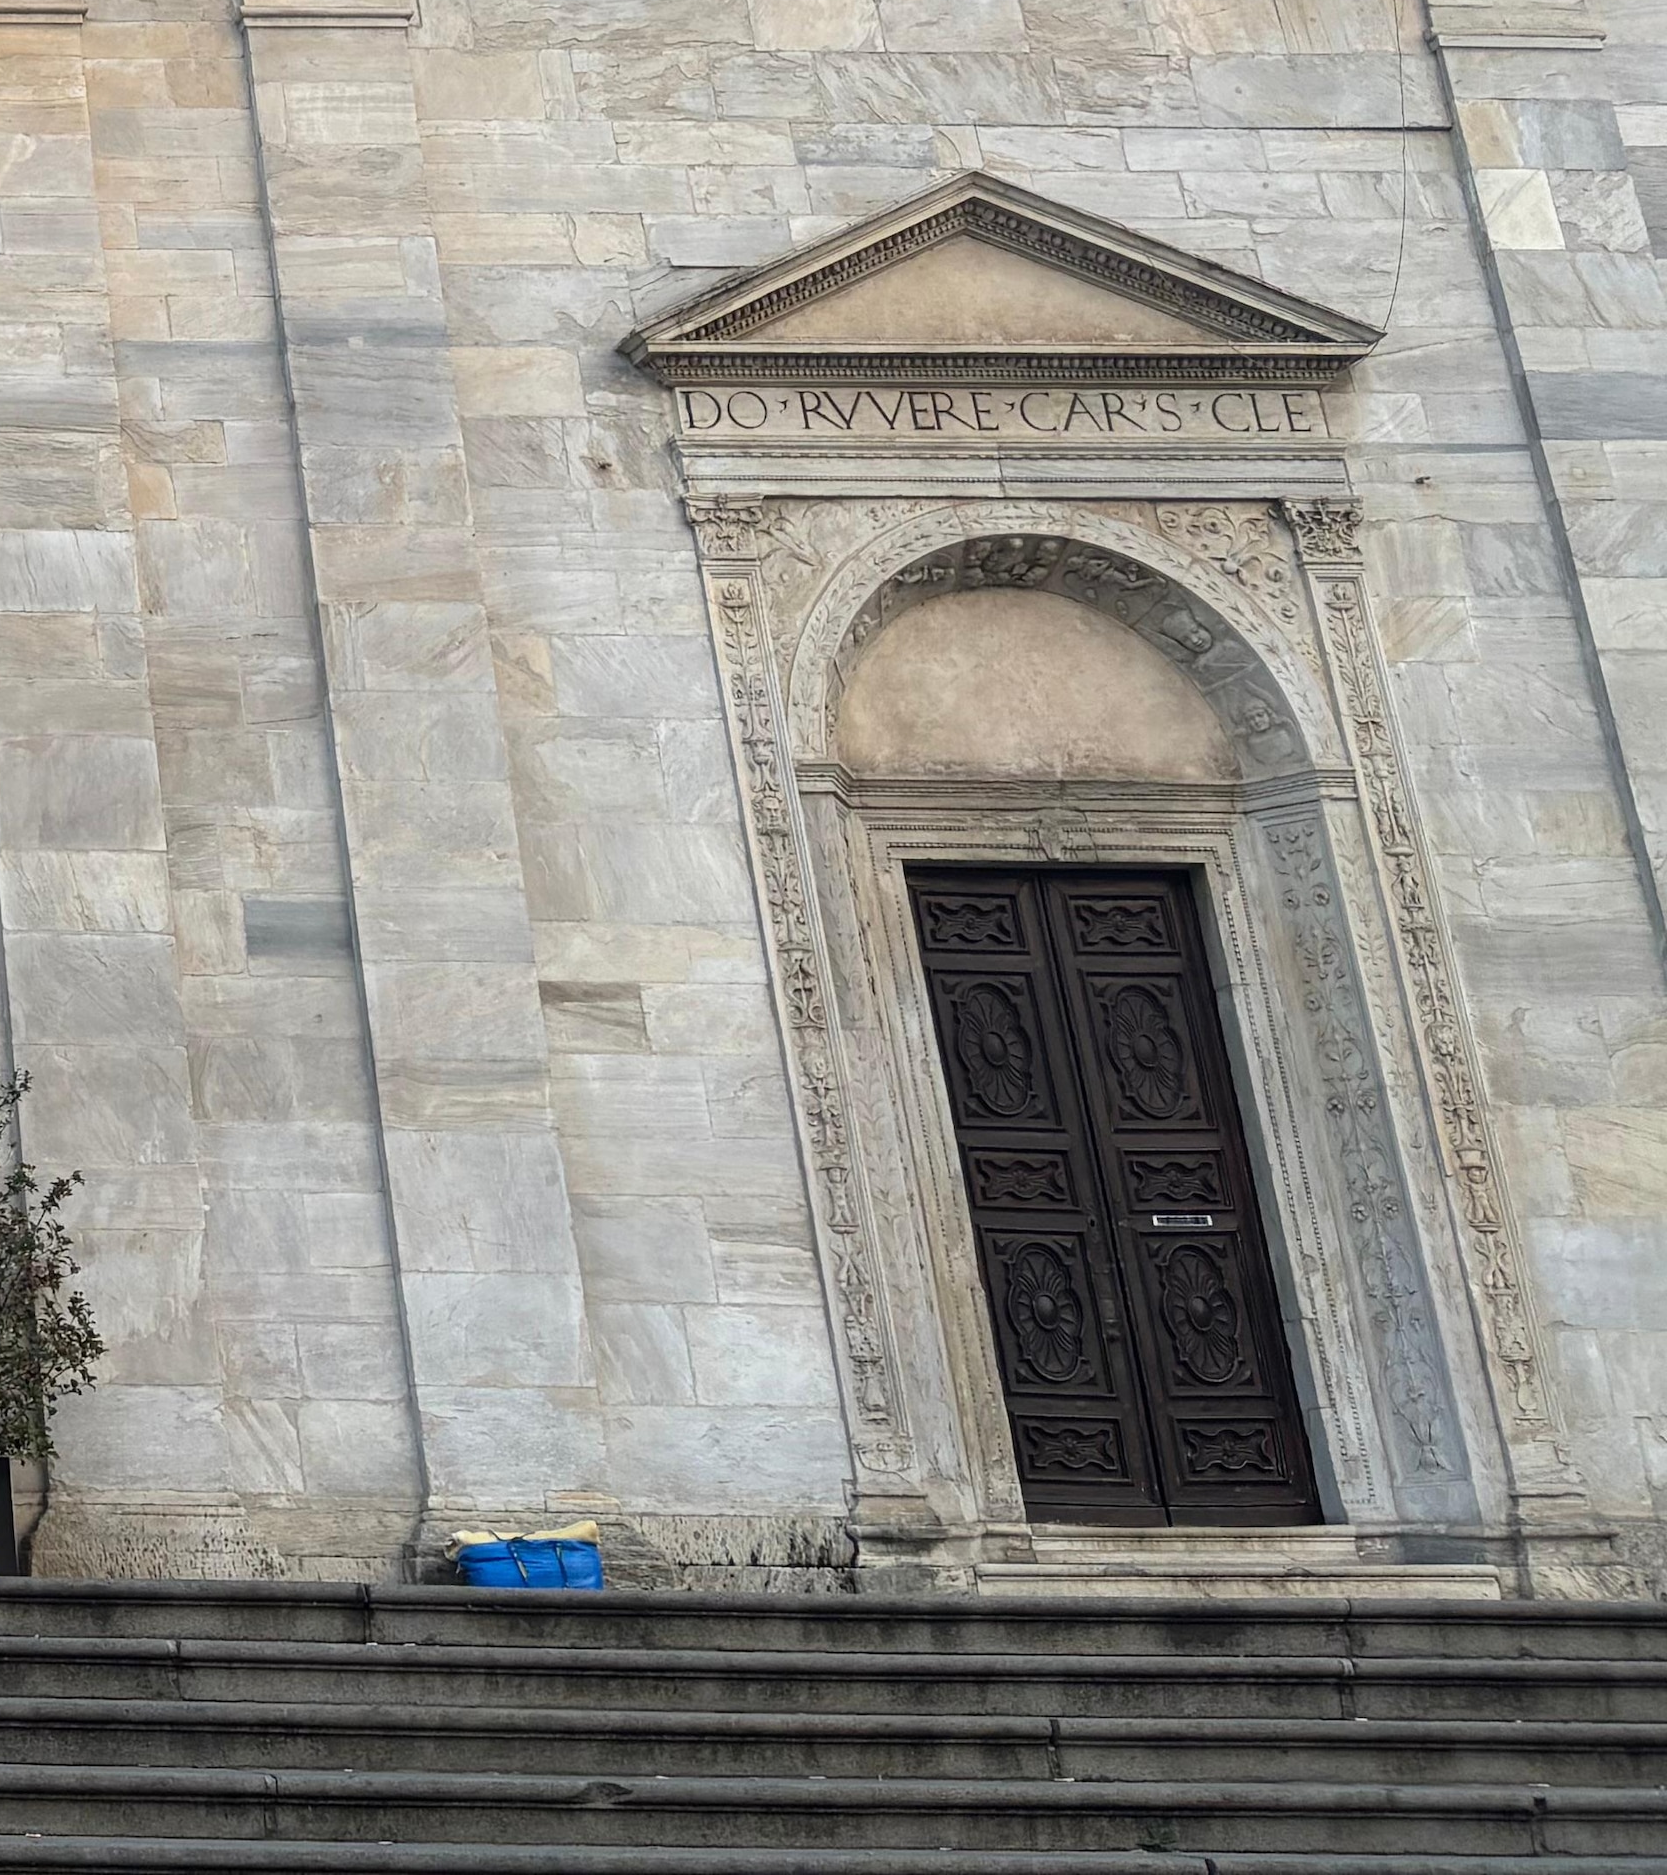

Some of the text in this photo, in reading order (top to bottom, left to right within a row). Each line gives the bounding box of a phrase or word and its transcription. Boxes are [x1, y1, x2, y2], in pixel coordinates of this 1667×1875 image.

[680, 391, 1312, 432] DO RVVERE CAR S CLE
